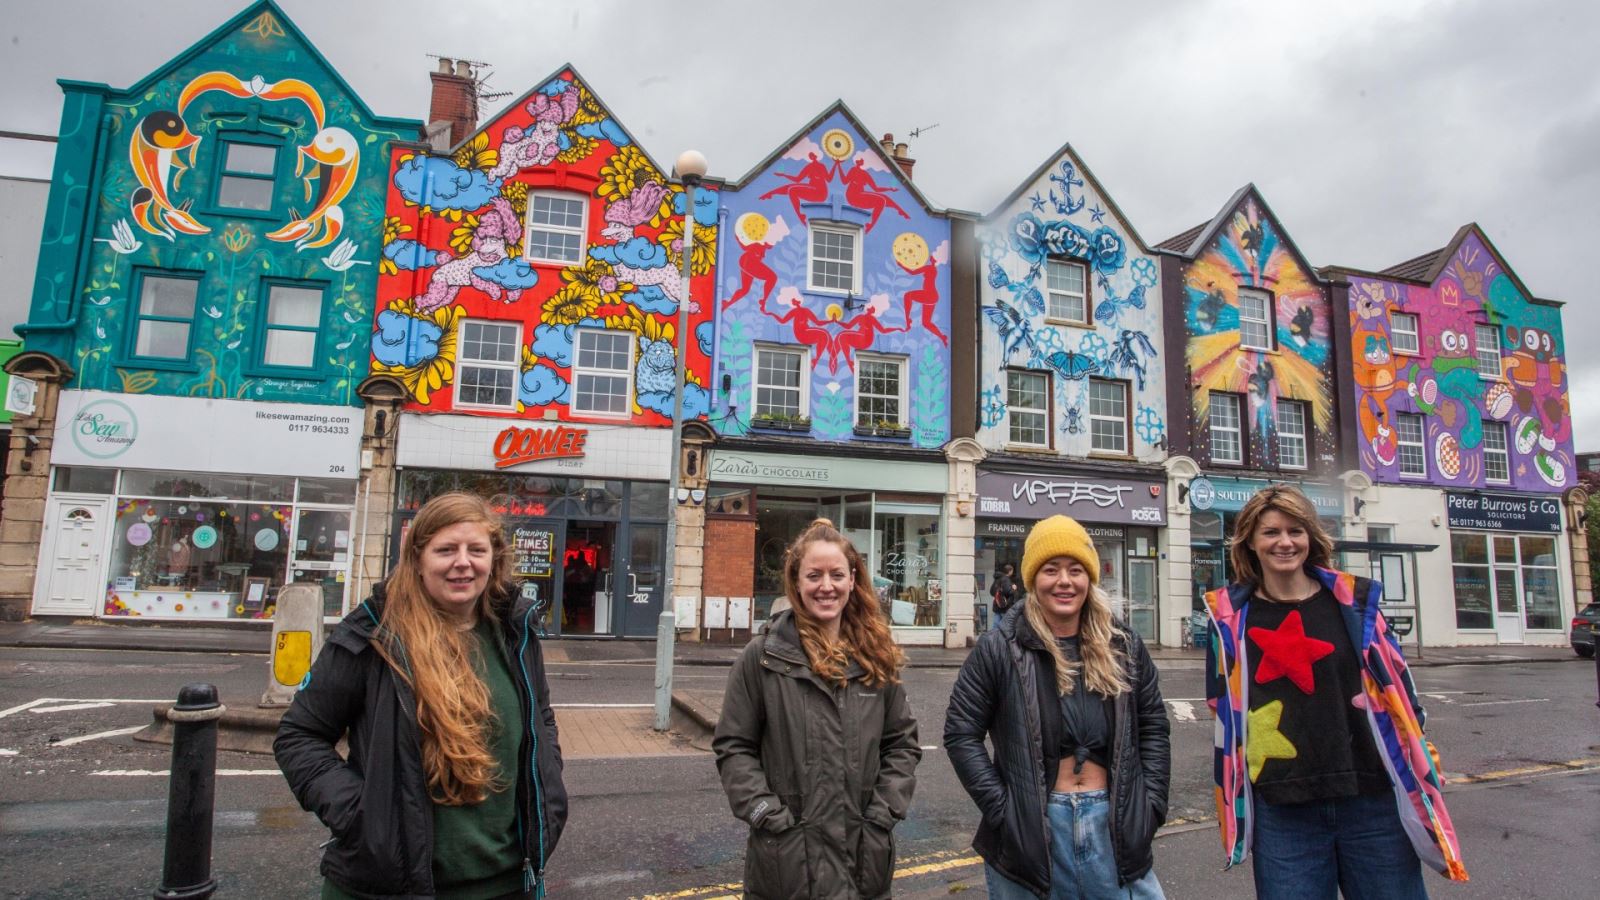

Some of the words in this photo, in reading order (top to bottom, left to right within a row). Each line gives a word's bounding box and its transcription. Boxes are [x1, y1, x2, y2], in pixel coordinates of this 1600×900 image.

[256, 411, 350, 424] likesewamazing.com
[81, 413, 120, 436] Sew
[289, 424, 309, 432] 0117
[312, 426, 349, 434] 9634333
[493, 425, 589, 460] OOWEE
[329, 465, 345, 473] 204
[557, 459, 584, 468] Diner
[713, 458, 758, 475] Zara's
[762, 467, 829, 480] CHOCOLATES
[1012, 480, 1133, 508] UPFEST
[1217, 490, 1250, 501] SOUTH
[980, 500, 1011, 513] KOBRA
[1449, 495, 1479, 509] Peter
[1481, 497, 1527, 512] Burrows
[1529, 500, 1538, 513] &
[1541, 501, 1559, 514] Co.
[1131, 509, 1161, 521] POSCA
[1487, 512, 1526, 520] SOLICITORS
[988, 523, 1025, 533] FRAMING
[1487, 520, 1502, 528] 6366
[515, 527, 548, 539] Opening
[1087, 528, 1123, 537] CLOTHING
[516, 538, 549, 550] TIMES
[633, 593, 649, 603] 202
[281, 633, 288, 641] T
[278, 642, 285, 650] 9
